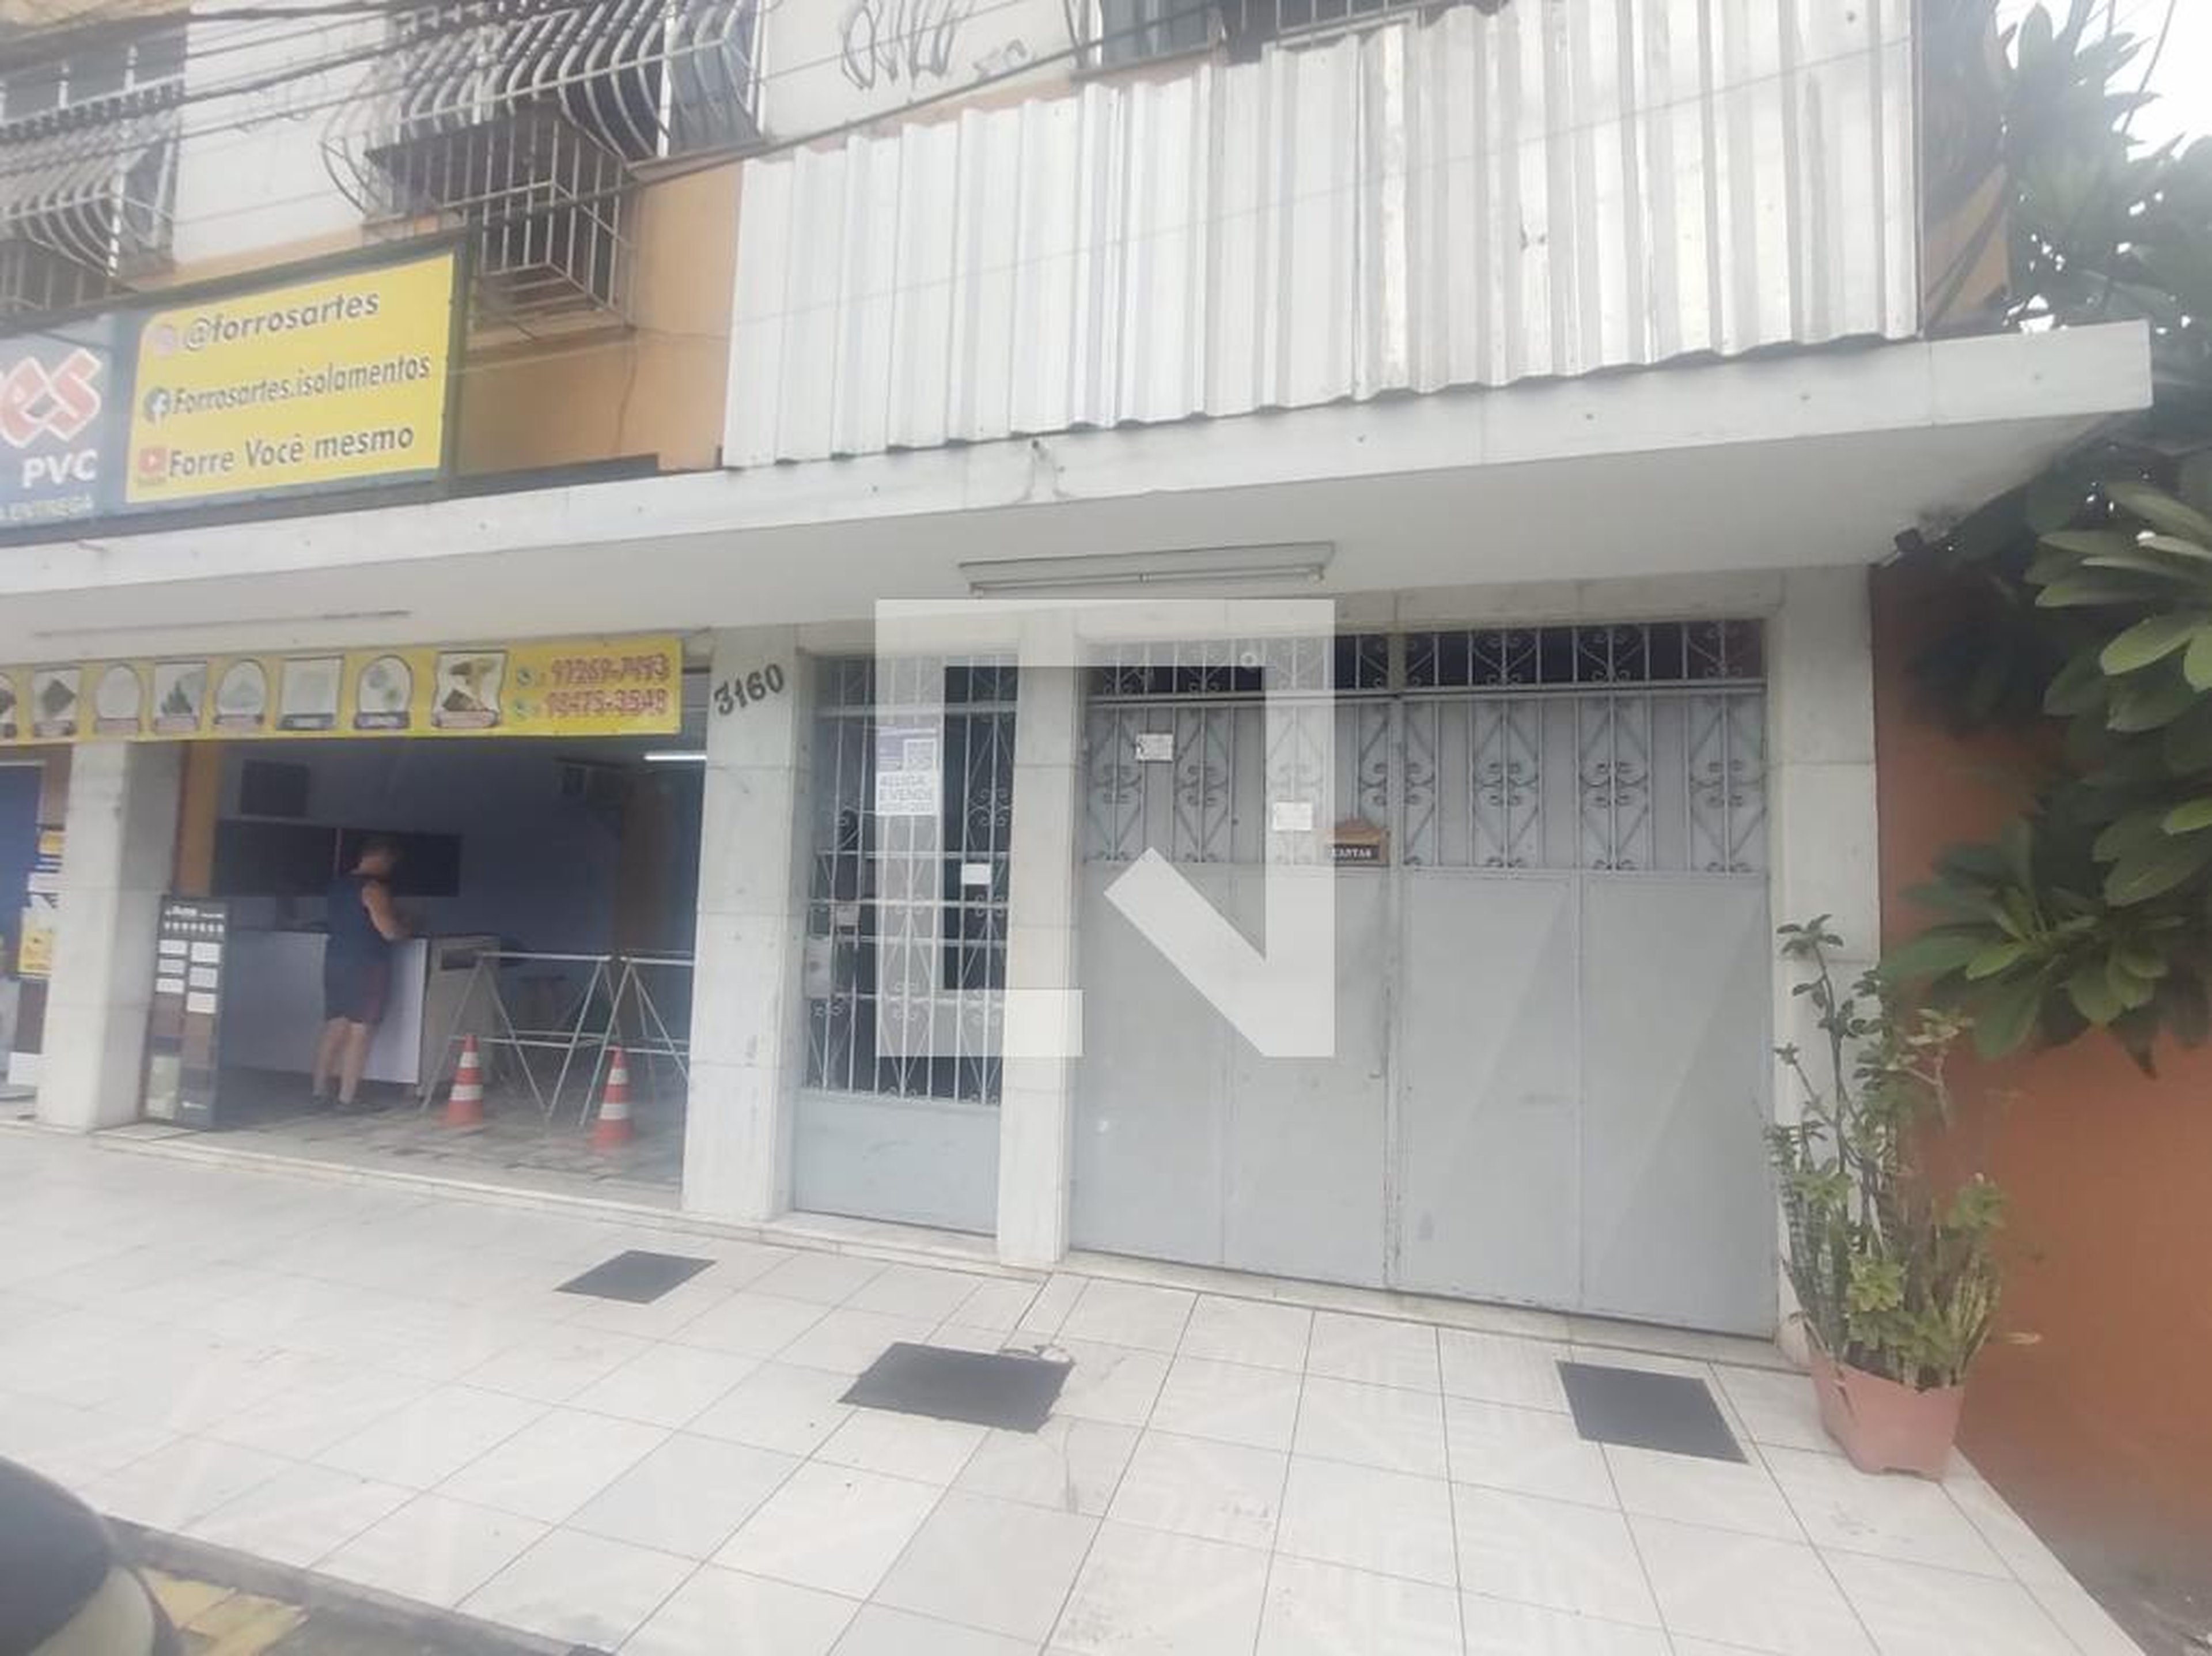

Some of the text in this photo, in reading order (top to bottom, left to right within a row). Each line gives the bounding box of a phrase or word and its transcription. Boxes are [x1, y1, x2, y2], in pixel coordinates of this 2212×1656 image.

[185, 293, 379, 351] @forrosartes
[23, 448, 99, 489] PVC
[169, 426, 415, 477] Forre Você mesmo
[714, 663, 785, 716] 3160
